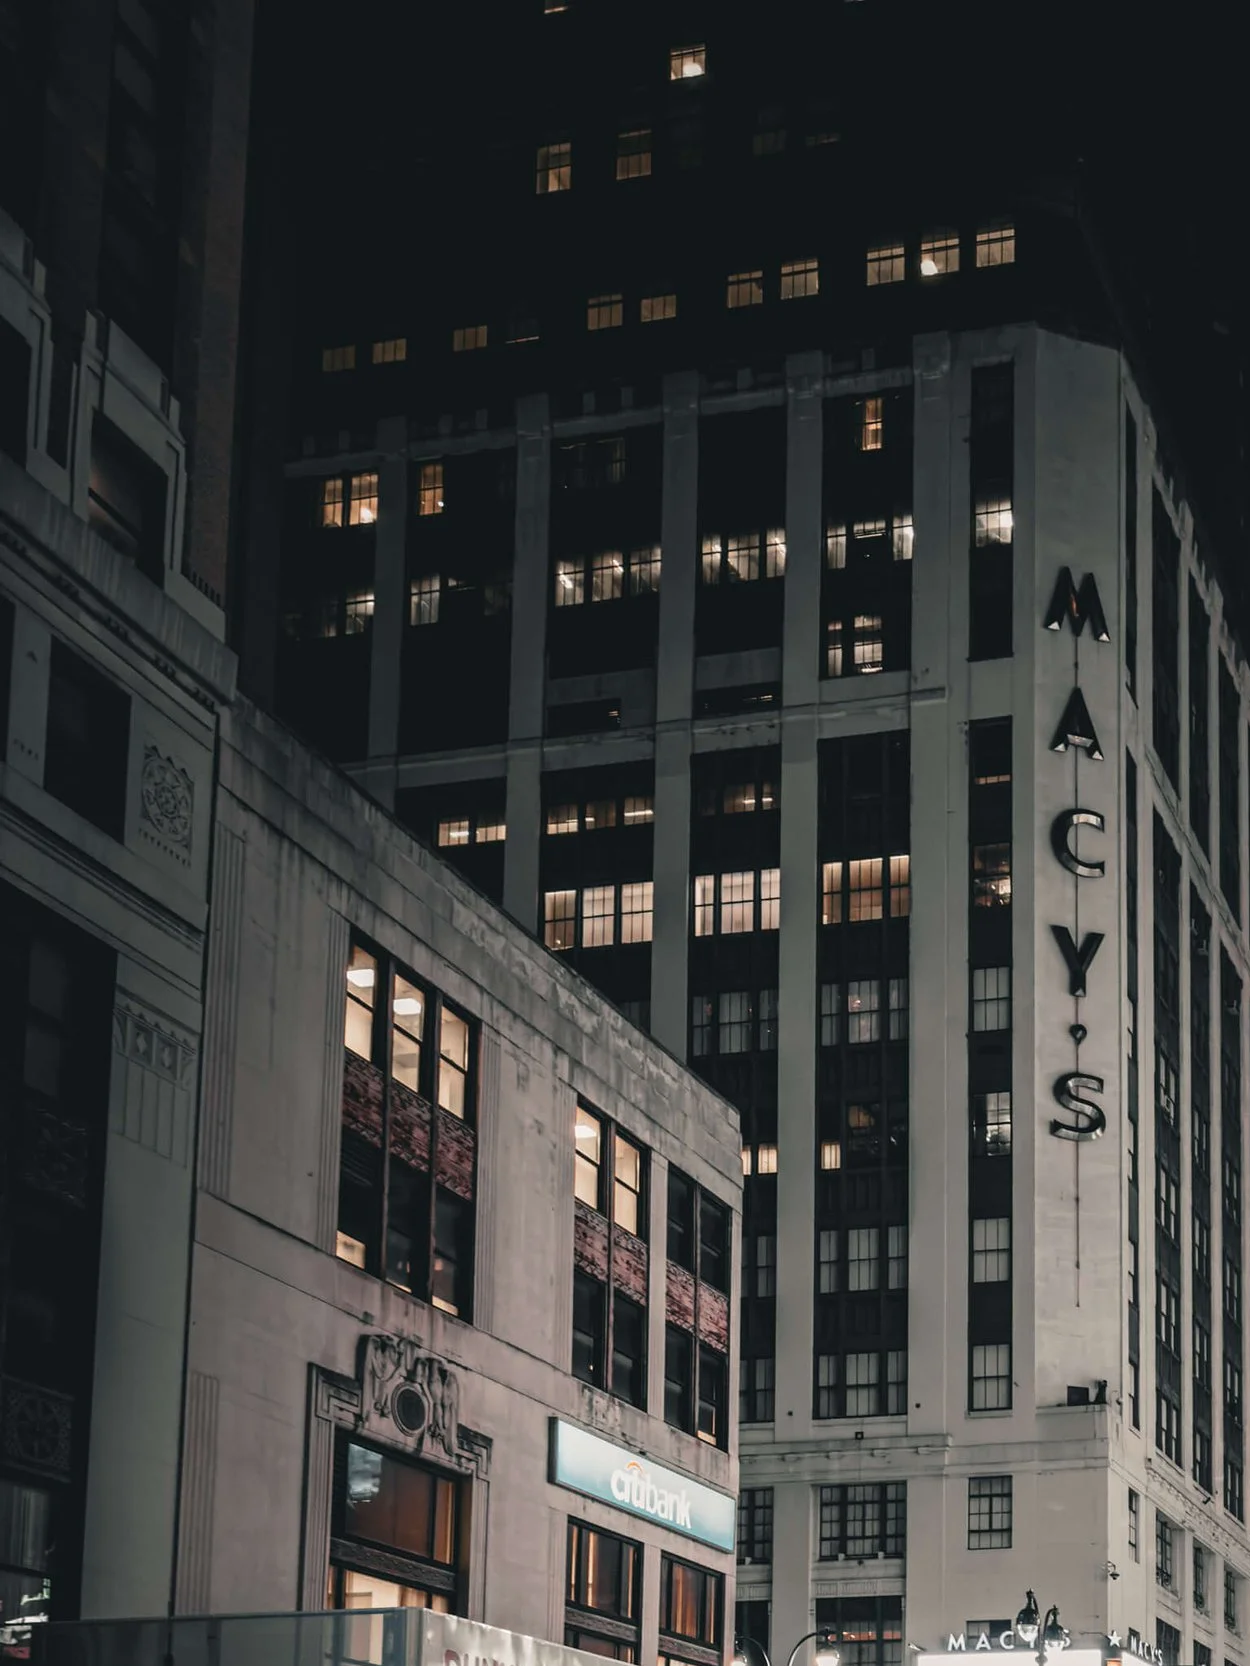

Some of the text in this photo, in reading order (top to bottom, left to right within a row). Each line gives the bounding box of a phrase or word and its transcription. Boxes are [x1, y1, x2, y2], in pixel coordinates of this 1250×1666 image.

[1043, 565, 1112, 1142] MACY'S
[610, 1467, 691, 1529] citibank
[947, 1629, 1071, 1651] MACYS
[1130, 1639, 1164, 1666] MACY'S
